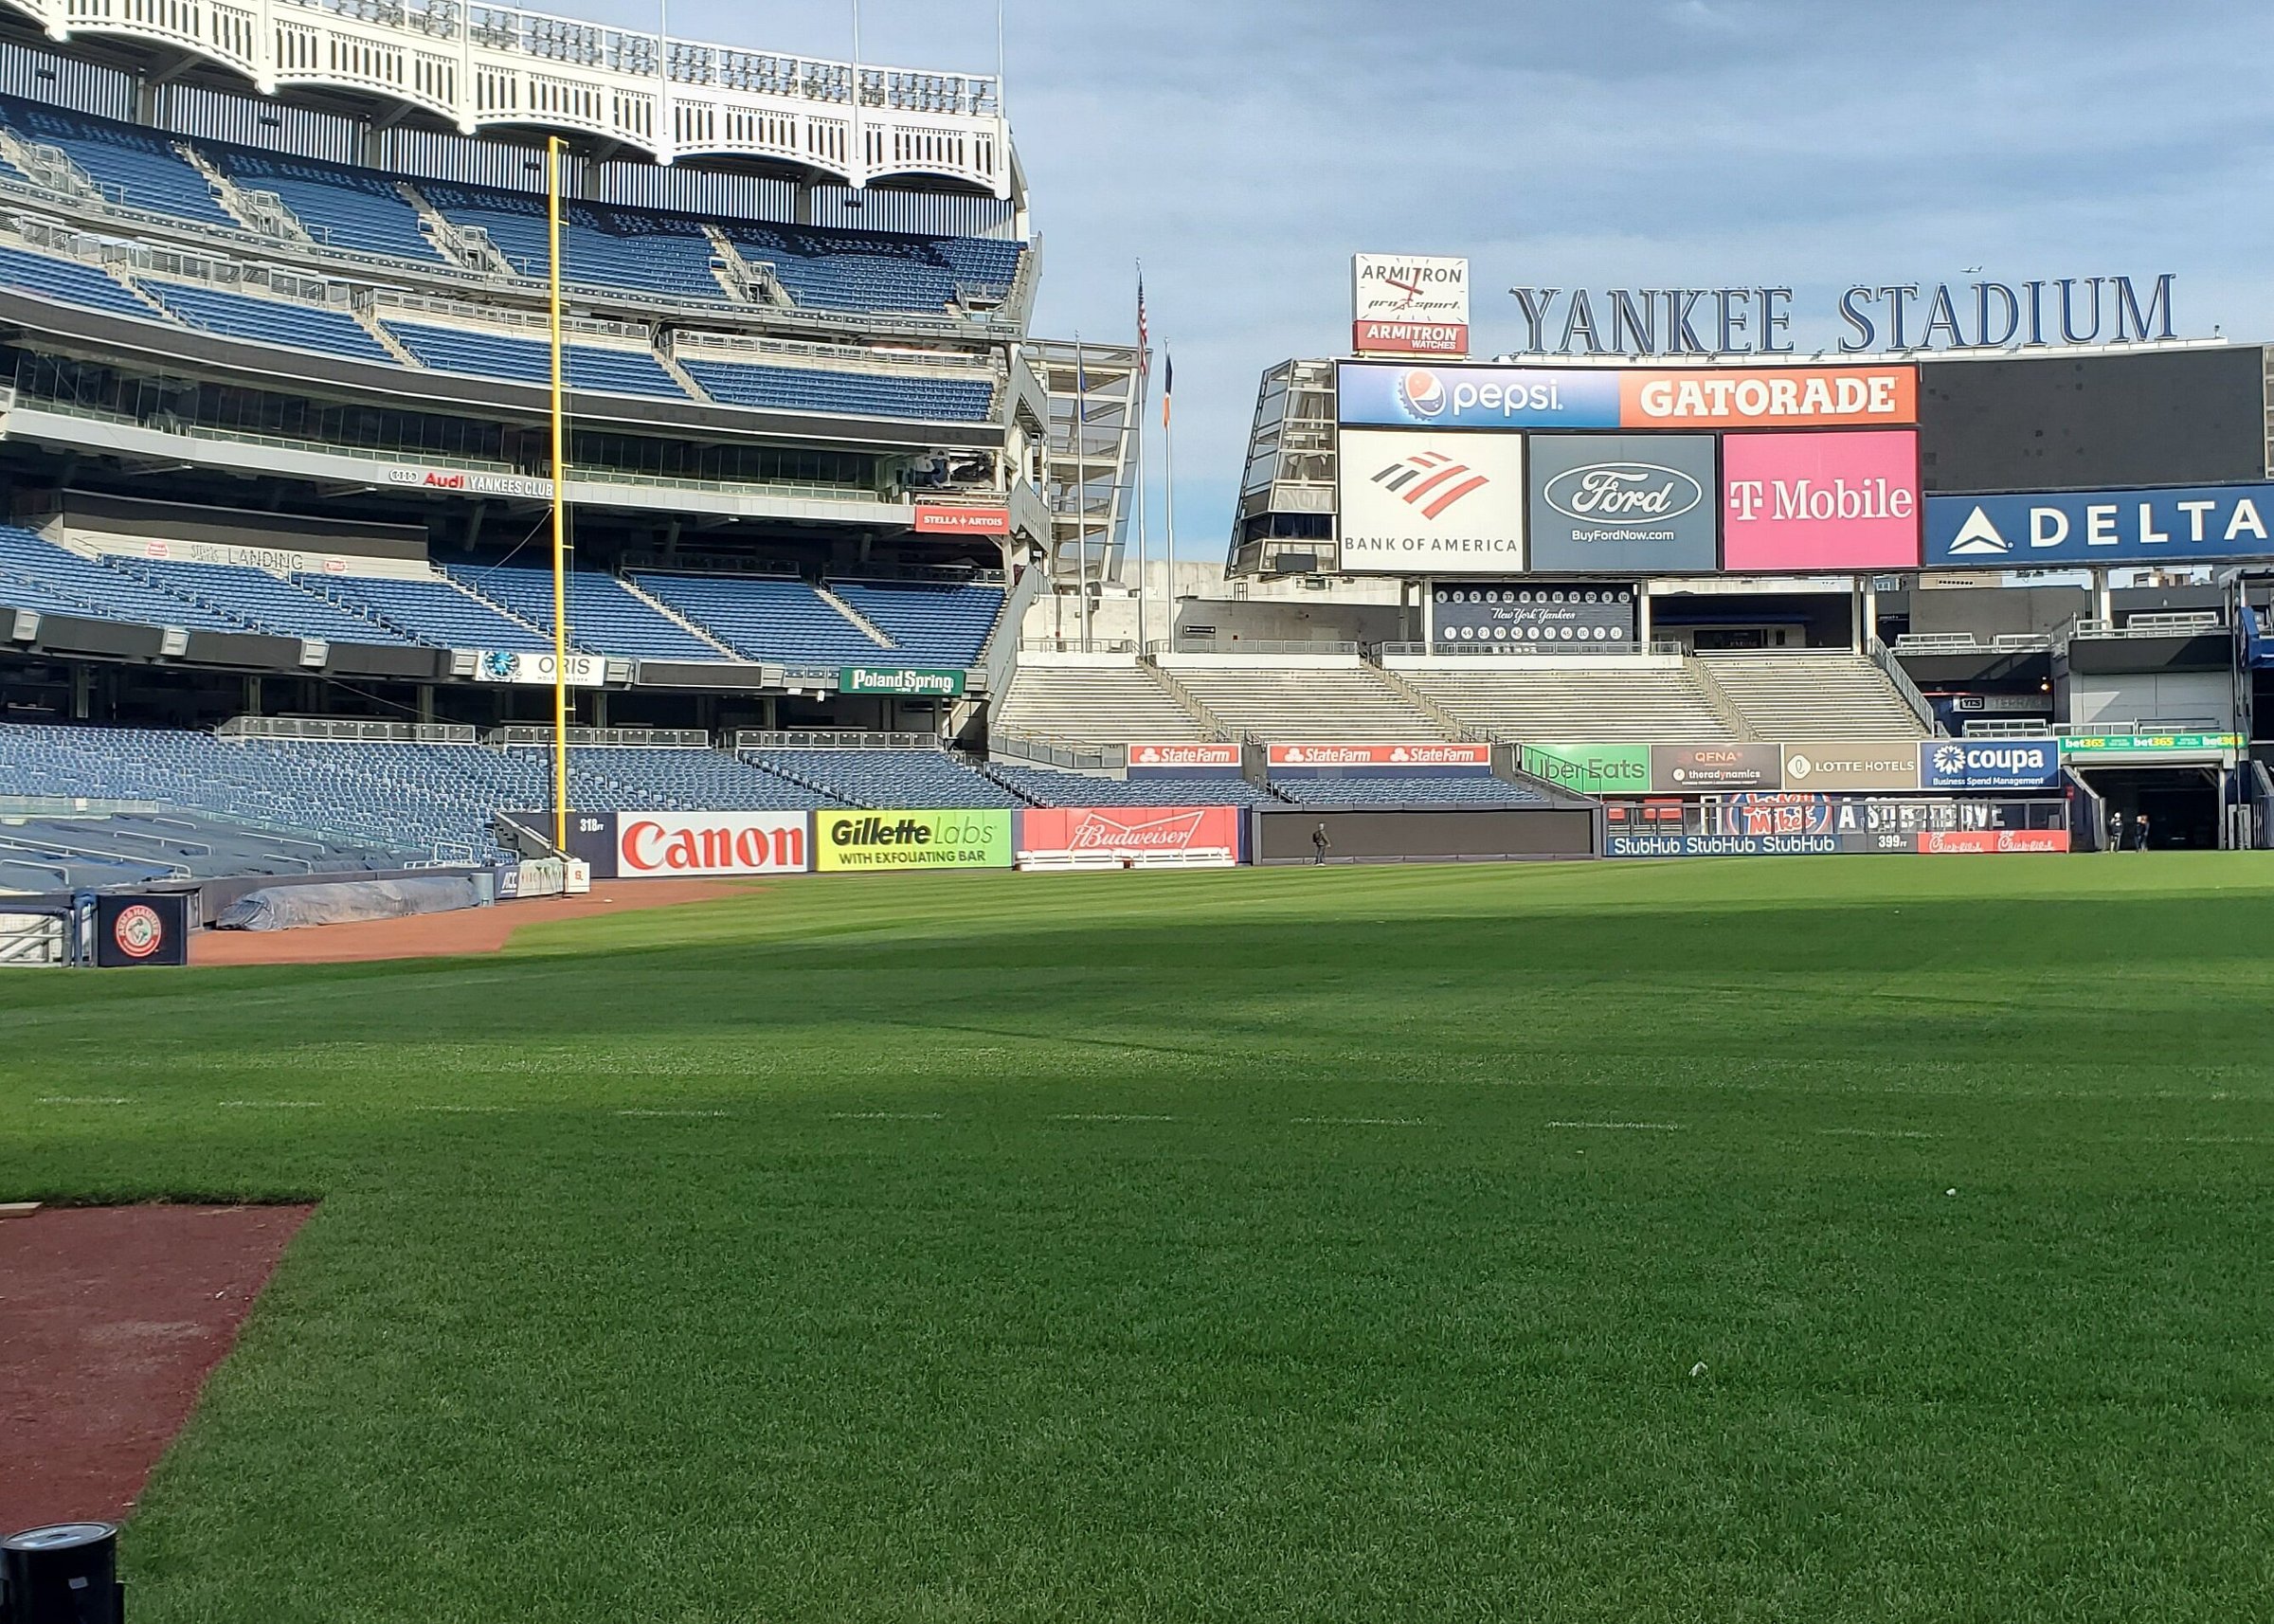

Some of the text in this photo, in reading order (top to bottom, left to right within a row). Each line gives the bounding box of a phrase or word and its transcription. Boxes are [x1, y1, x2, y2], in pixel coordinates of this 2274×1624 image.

[1362, 265, 1462, 283] ARMITRON
[1512, 273, 2178, 355] YANKEE STADIUM
[1367, 324, 1457, 341] ARMITRON
[1412, 339, 1456, 350] WATCHES
[1640, 377, 1896, 417] GATORADE
[424, 472, 553, 497] Audi YANKEES CLUB
[1572, 470, 1675, 514] Ford
[1772, 479, 1913, 520] Mobile
[924, 515, 1003, 526] STELLA ARTOIS
[2030, 498, 2268, 548] DELTA
[1345, 537, 1518, 552] BANK OF AMERICA
[1571, 528, 1675, 543] BuyFordNow.com
[228, 547, 303, 570] LANDING
[1490, 607, 1576, 624] New York Yankees
[853, 669, 954, 694] Poland Spring
[2065, 737, 2105, 749] bet365
[2134, 736, 2174, 748] bet365
[1528, 758, 1646, 779] Uber Eats
[1814, 760, 1915, 772] LOTTE HOTELS
[1967, 749, 2045, 774] coupa
[1933, 777, 2044, 786] Business Spend Management
[1839, 797, 1856, 829] A
[830, 816, 994, 846] Gillette Labs
[1075, 823, 1190, 848] Budweiser
[622, 820, 804, 871] Canon
[1614, 835, 1834, 854] StubHub StubHub StubHub
[839, 850, 986, 865] WITH EXFOLIATING BAR
